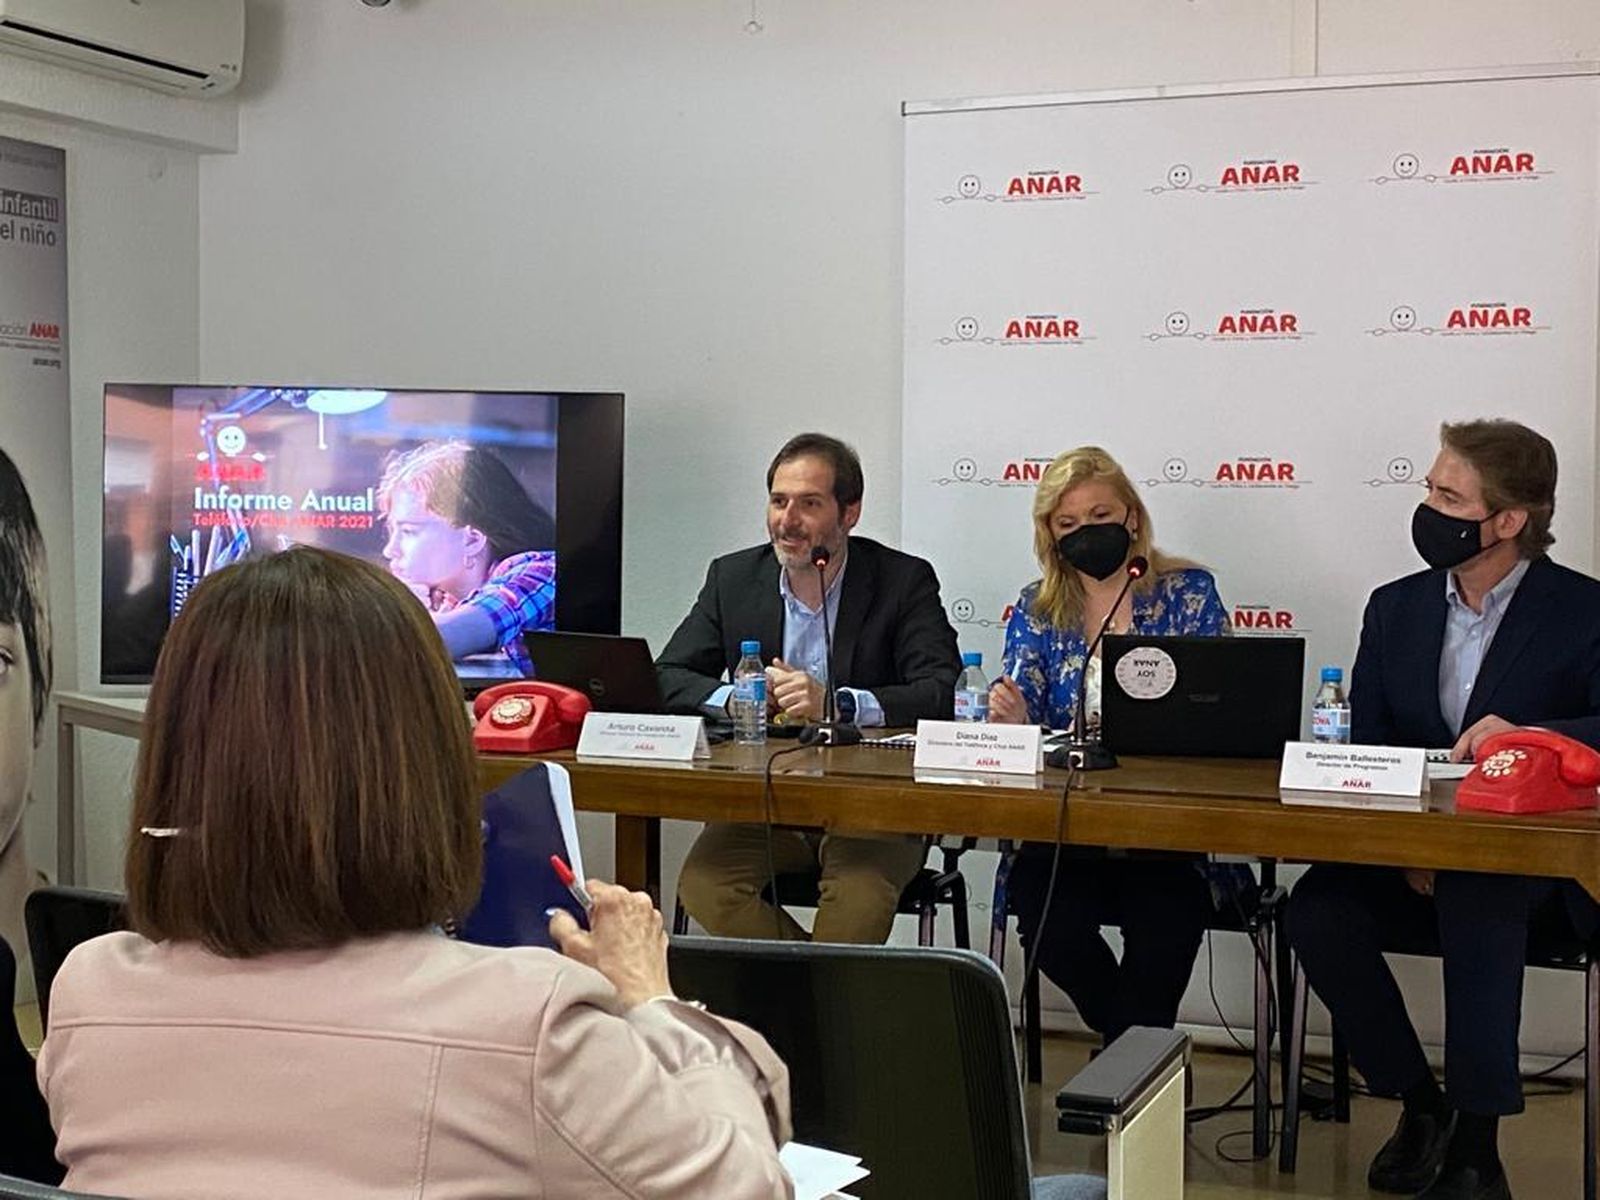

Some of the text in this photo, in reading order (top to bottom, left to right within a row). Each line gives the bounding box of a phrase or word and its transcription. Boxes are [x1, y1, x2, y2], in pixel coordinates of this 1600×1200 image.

[1449, 153, 1535, 175] ANAR
[1220, 164, 1300, 185] ANAR
[1007, 175, 1082, 195] ANAR
[20, 222, 57, 247] niño
[1218, 314, 1298, 334] ANAR
[1447, 308, 1532, 328] ANAR
[29, 322, 60, 339] ANAR
[1005, 319, 1080, 339] ANAR
[1003, 463, 1050, 481] AN
[1216, 463, 1295, 482] ANAR
[194, 485, 374, 512] Informe Anual
[339, 514, 374, 528] 2021
[1233, 610, 1294, 629] NAR
[976, 758, 1001, 767] ANAR
[1341, 779, 1372, 789] ANAR
